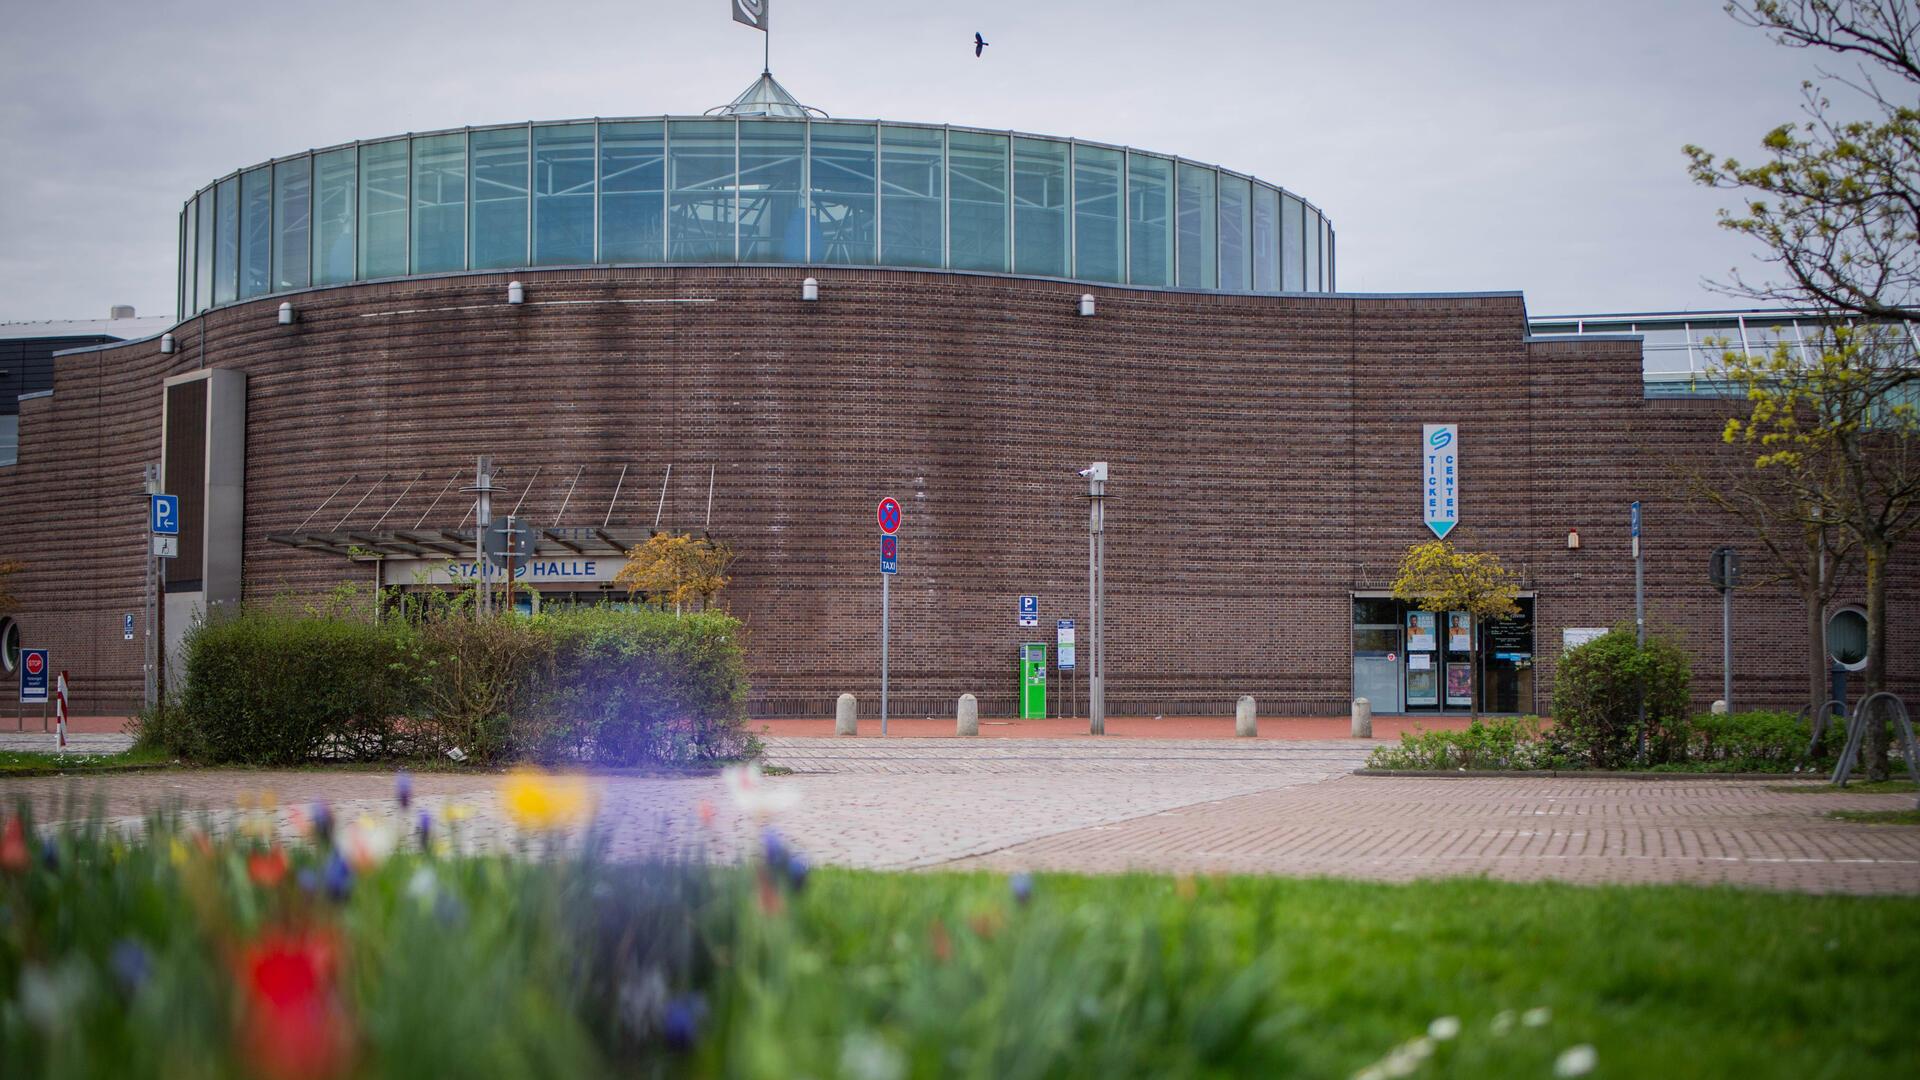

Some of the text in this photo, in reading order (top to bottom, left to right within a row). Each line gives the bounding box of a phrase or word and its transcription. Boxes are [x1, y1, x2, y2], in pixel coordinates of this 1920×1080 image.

[1428, 455, 1437, 517] TICKET
[1445, 455, 1454, 517] CENTER
[156, 499, 170, 528] P
[533, 561, 596, 576] HALLE
[882, 561, 896, 571] TAXI
[1024, 597, 1033, 608] P
